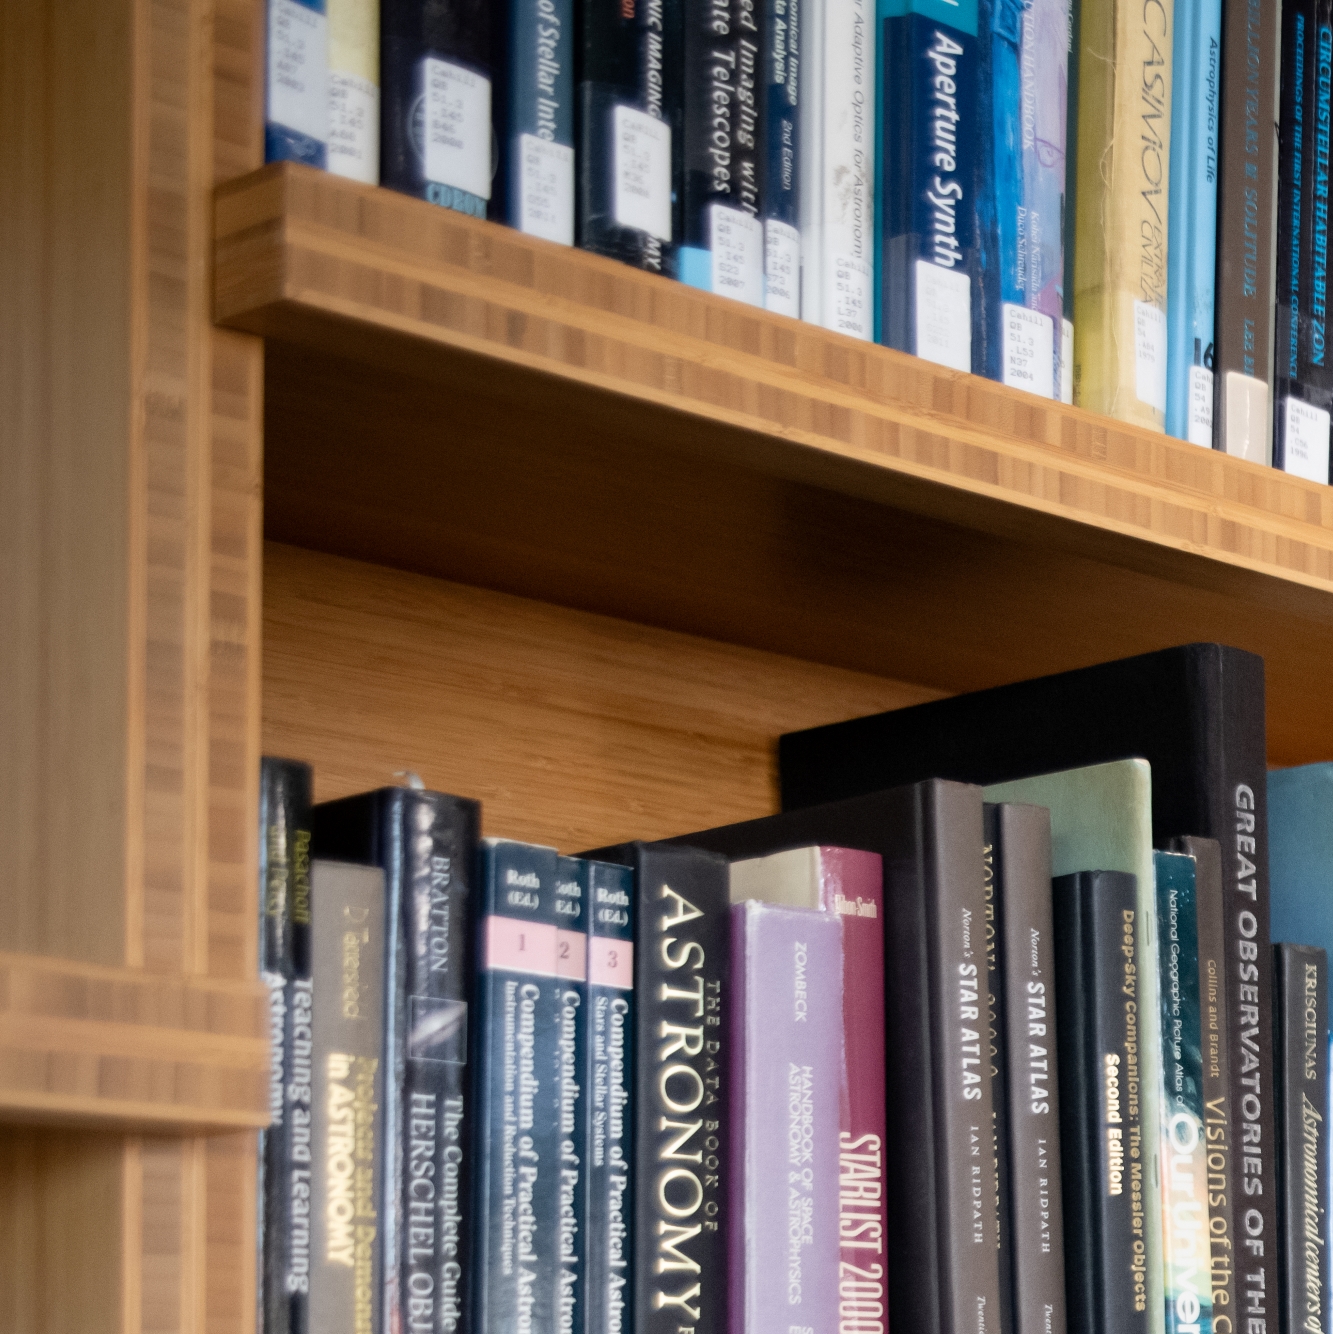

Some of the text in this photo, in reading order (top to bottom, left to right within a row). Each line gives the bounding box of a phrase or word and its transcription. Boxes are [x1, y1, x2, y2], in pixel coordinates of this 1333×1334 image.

[538, 24, 560, 96] Stellar
[772, 18, 788, 84] Analysis
[852, 10, 865, 169] Adaptive Optics for
[928, 30, 964, 172] Aperture
[709, 49, 735, 194] Telescopes
[737, 39, 757, 219] Imaging with
[1206, 36, 1219, 184] Astrophysics of Life
[1316, 26, 1333, 198] CIRCUMSTELLAR
[1313, 200, 1328, 317] HABITABLE
[1235, 785, 1257, 901] GREAT
[430, 856, 452, 974] BRATTON
[961, 907, 974, 959] Norton's
[1030, 927, 1042, 977] Norton's
[794, 941, 808, 1022] ZOMBECK
[959, 963, 980, 1020] STAR
[1027, 981, 1047, 1037] STAR
[1168, 889, 1184, 1092] National Geographic Picture Atlas
[1304, 963, 1318, 1080] KRISCIUNAS
[517, 983, 541, 1130] Compendium
[558, 990, 581, 1133] Compendium
[607, 998, 629, 1140] Compendium
[660, 883, 706, 1320] ASTRONOMY
[704, 979, 721, 1232] THE DATA BOOK OF
[961, 1027, 983, 1100] ATLAS
[1029, 1043, 1050, 1115] ATLAS
[1238, 909, 1264, 1196] OBSERVATORIES
[284, 976, 313, 1295] Teaching and Learning
[442, 1094, 465, 1141] The
[519, 1136, 539, 1162] of
[561, 1139, 580, 1165] of
[609, 1145, 628, 1171] of
[801, 1065, 814, 1245] HANDBOOK OF SPACE
[970, 1126, 982, 1157] IAN
[1039, 1139, 1049, 1169] IAN
[1105, 1053, 1125, 1196] Second Edition
[1121, 909, 1147, 1312] Deep-Sky Companions: The Messier Objects
[1207, 1097, 1227, 1207] Visions
[1301, 1091, 1324, 1241] Astronomical
[326, 1082, 357, 1268] ASTRONOMY
[408, 1092, 437, 1265] HERSCHEL
[438, 1145, 464, 1258] Complete
[517, 1165, 539, 1262] Practical
[559, 1168, 580, 1262] Practical
[609, 1173, 628, 1267] Practical
[788, 1064, 802, 1306] ASTRONOMY & ASTROPHYSICS
[838, 1130, 883, 1254] STARLIST
[971, 1165, 984, 1244] RIDPATH
[1039, 1177, 1051, 1253] RIDPATH
[1211, 1216, 1232, 1251] of
[1211, 1256, 1232, 1305] the
[1244, 1208, 1265, 1257] OF
[1304, 1242, 1321, 1313] centers
[441, 1261, 462, 1333] Guide
